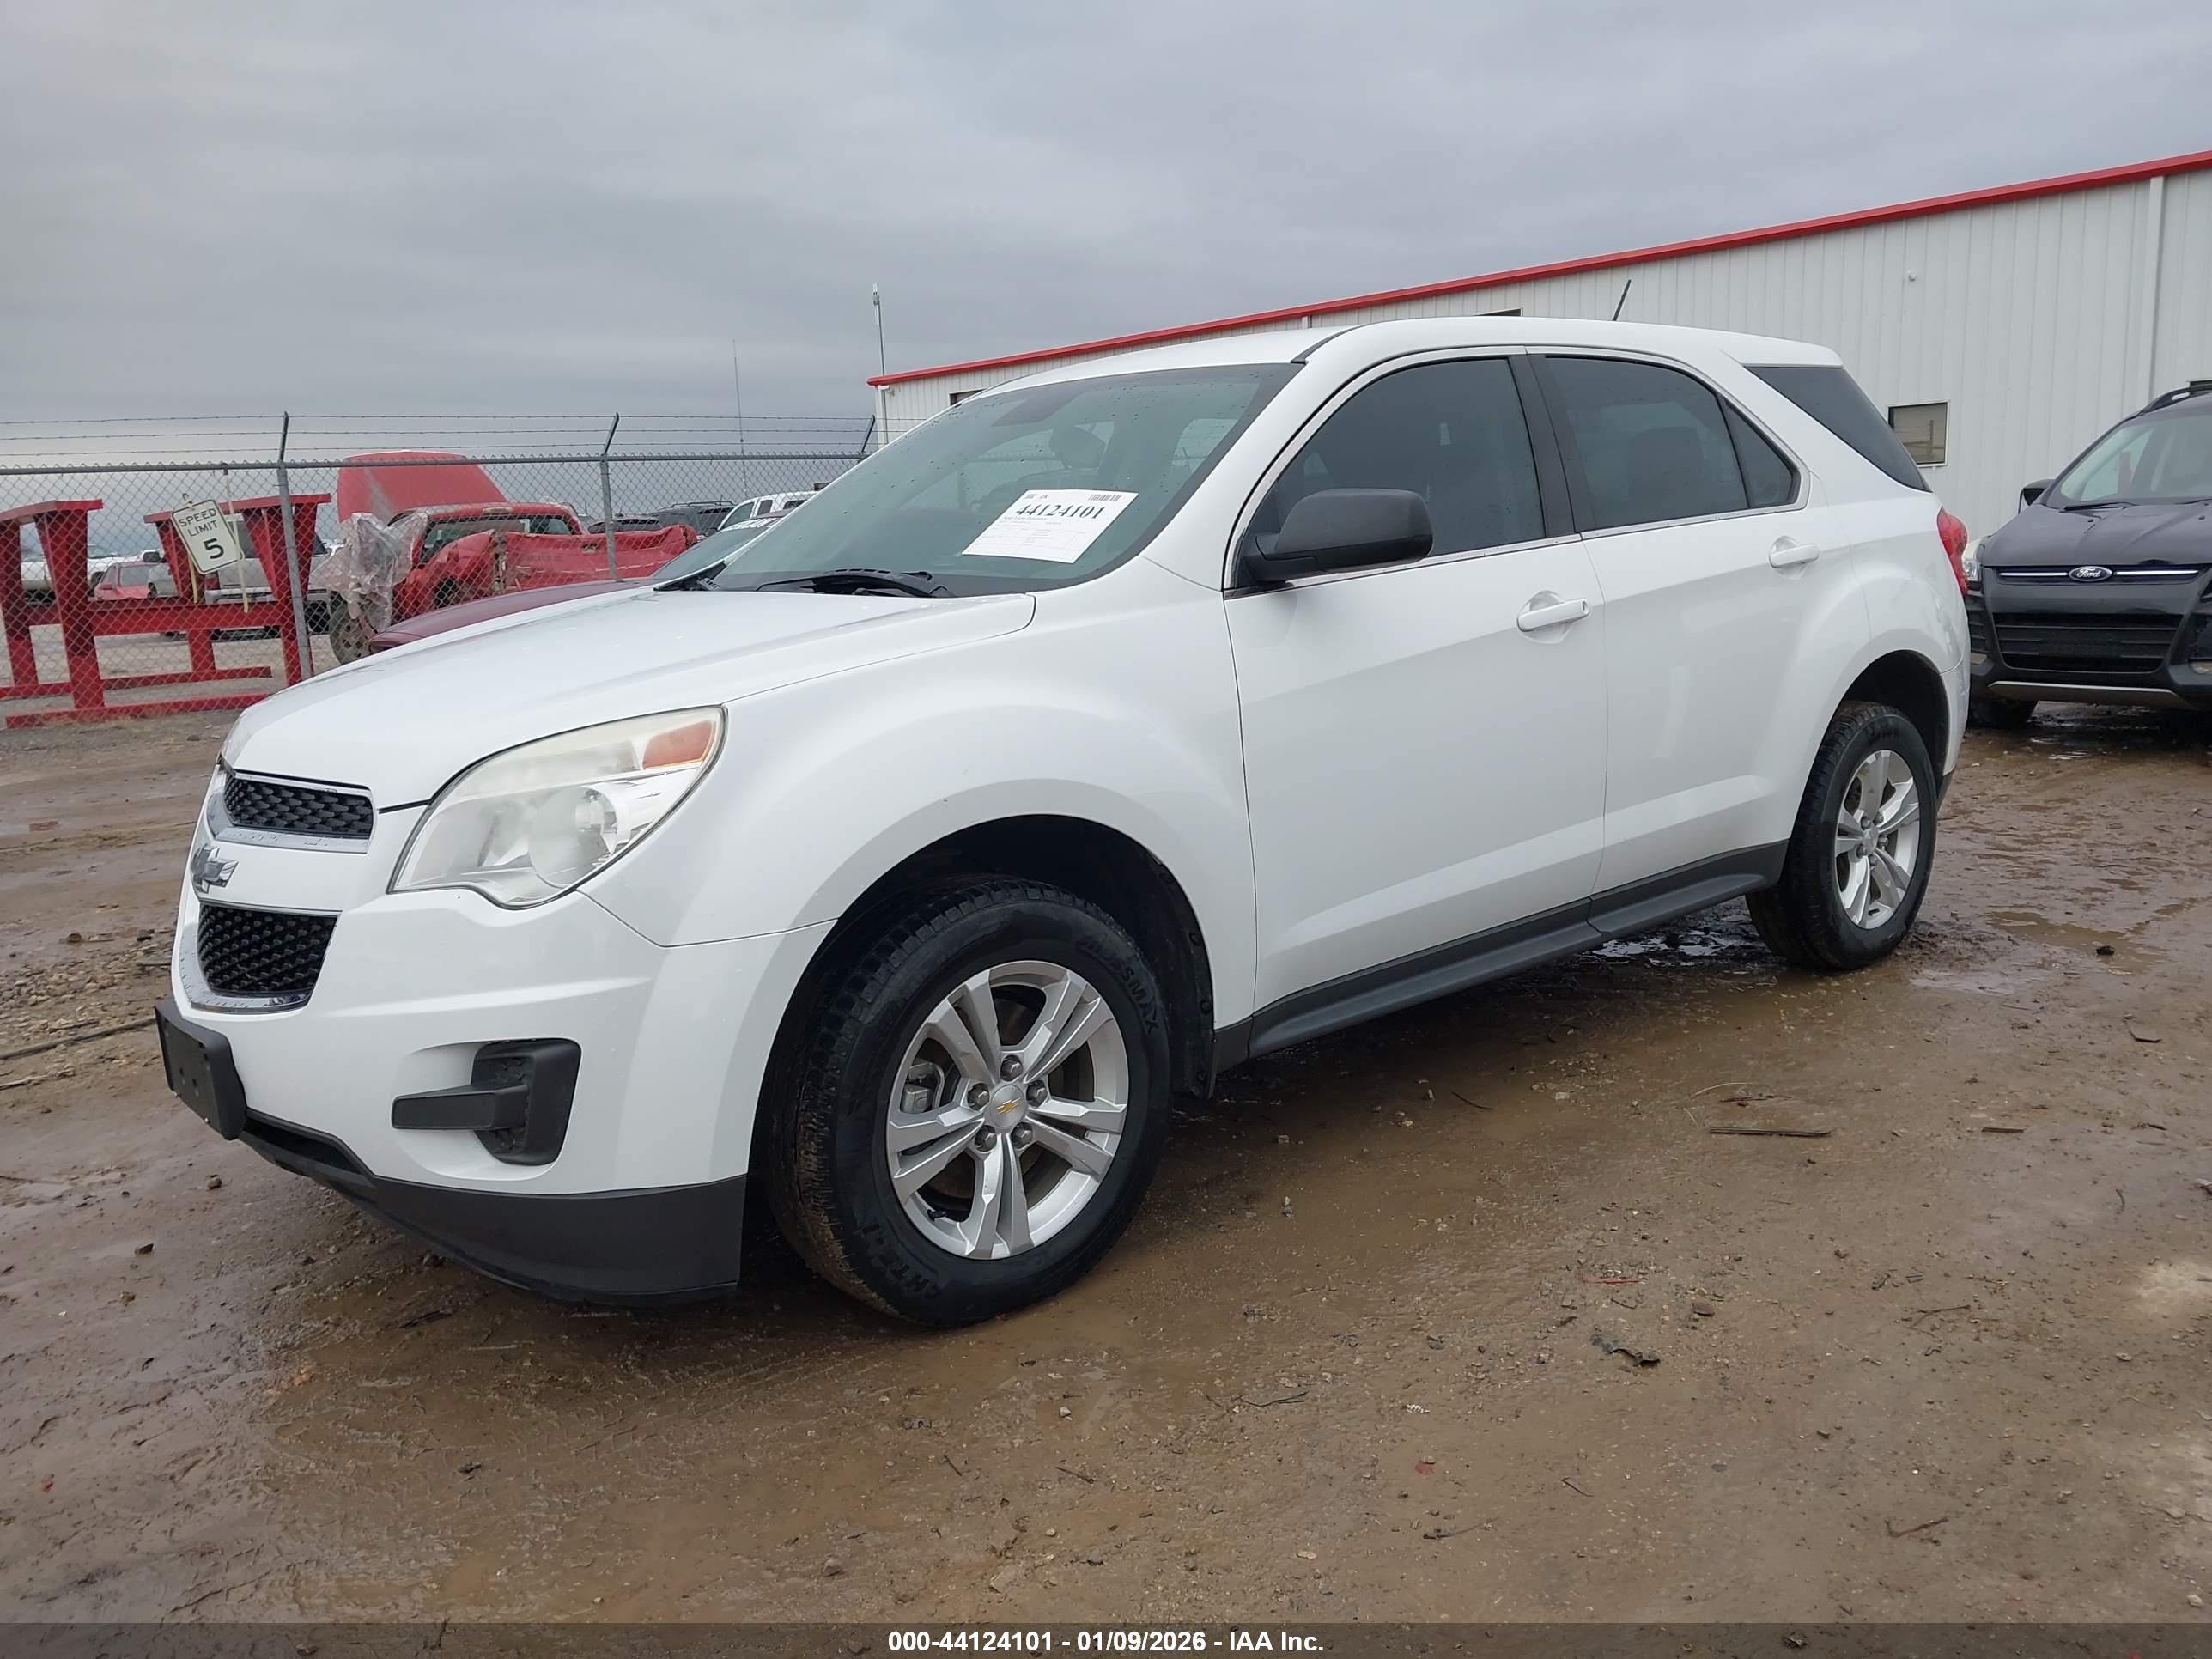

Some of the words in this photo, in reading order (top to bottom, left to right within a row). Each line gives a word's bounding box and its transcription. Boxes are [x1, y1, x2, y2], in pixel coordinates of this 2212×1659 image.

[179, 508, 216, 527] SPEED
[1016, 503, 1106, 519] 44124101
[187, 520, 218, 537] LIMIT
[203, 538, 224, 560] 5
[2076, 568, 2102, 578] Ford
